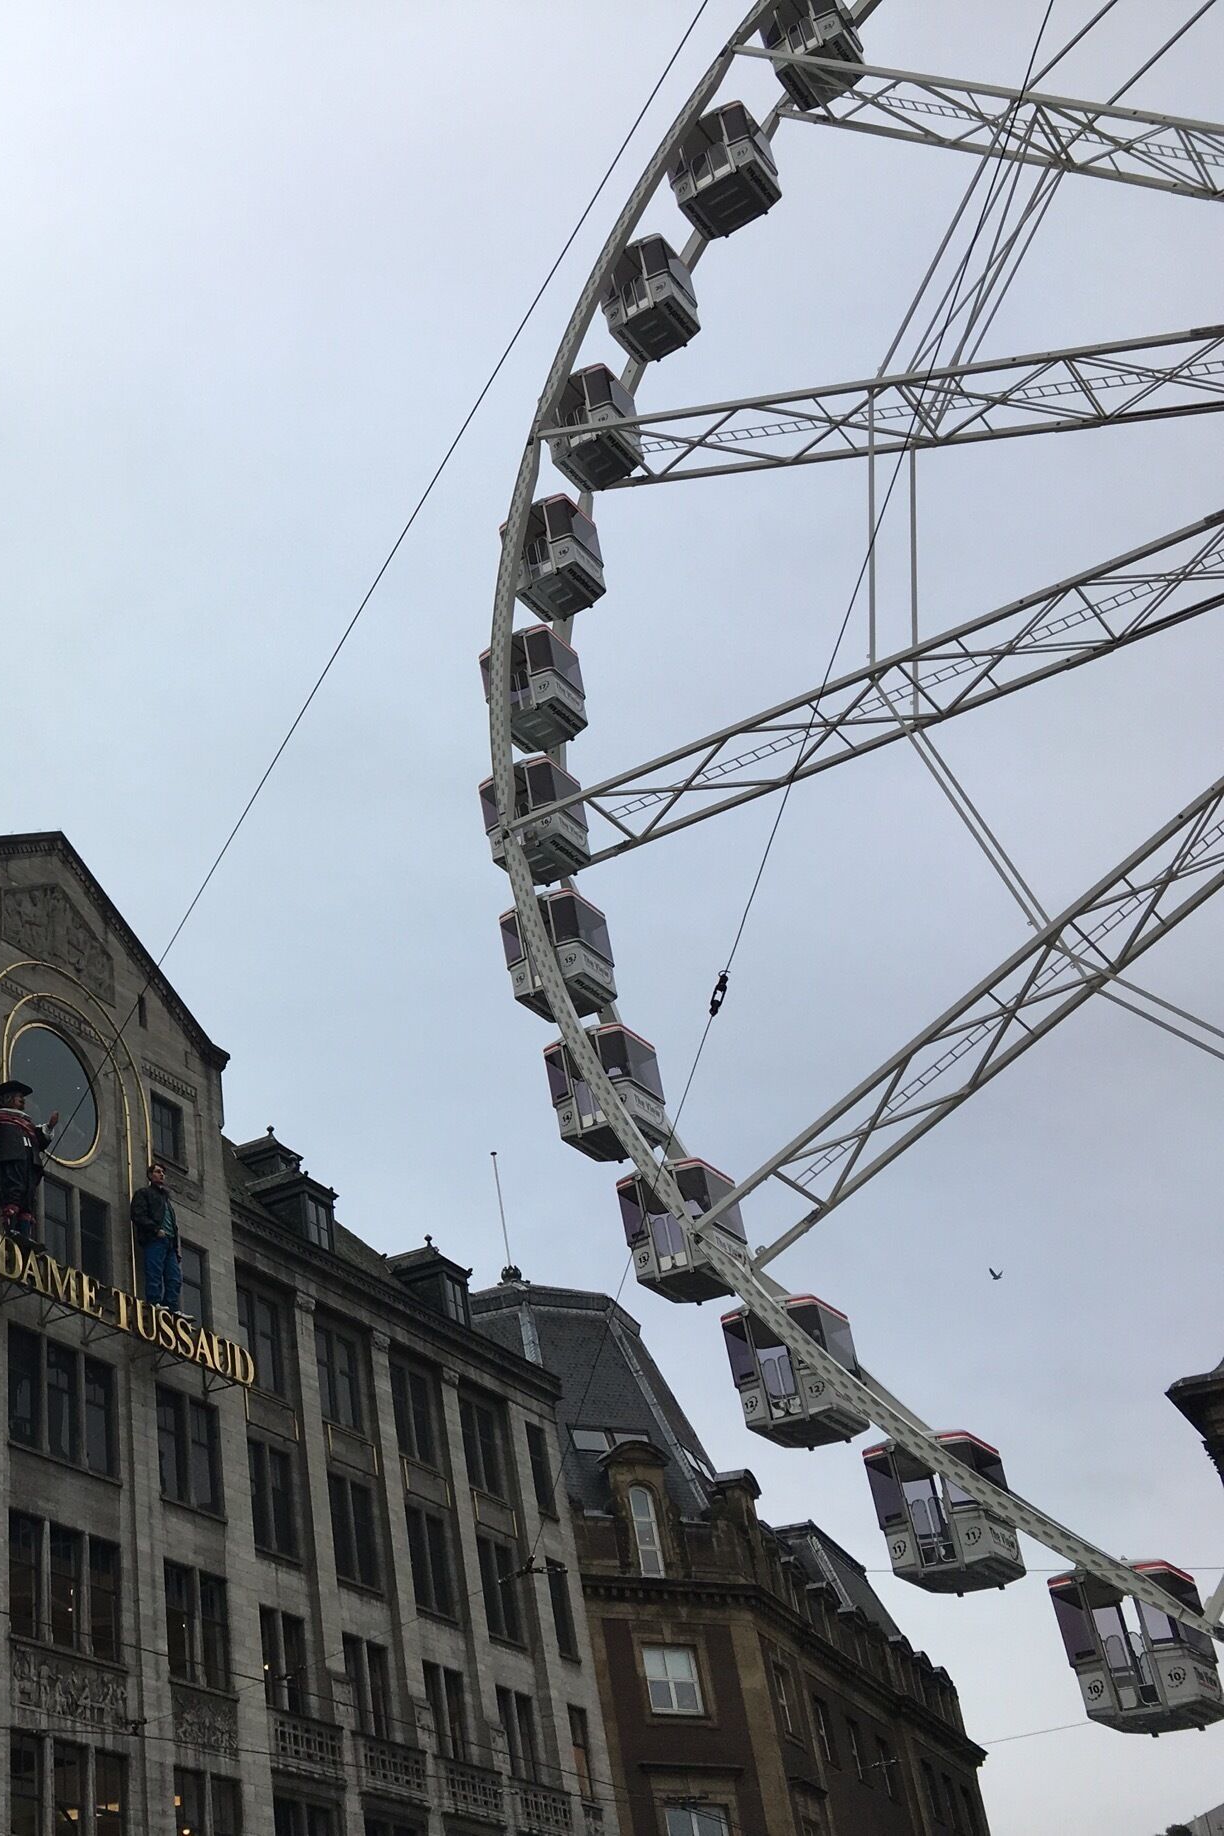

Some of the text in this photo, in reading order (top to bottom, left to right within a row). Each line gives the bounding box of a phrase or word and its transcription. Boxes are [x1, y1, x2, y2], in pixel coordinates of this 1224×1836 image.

[633, 1094, 660, 1118] The View
[638, 1255, 648, 1264] 13
[111, 1287, 255, 1387] TUSSAUD
[808, 1384, 821, 1394] 12
[744, 1400, 754, 1410] 12
[965, 1531, 977, 1541] 11
[989, 1526, 1001, 1542] The
[999, 1532, 1016, 1550] View
[892, 1545, 903, 1554] 11
[1167, 1671, 1182, 1682] 10
[1193, 1666, 1204, 1681] The
[1202, 1671, 1218, 1688] View
[1087, 1684, 1100, 1695] 10
